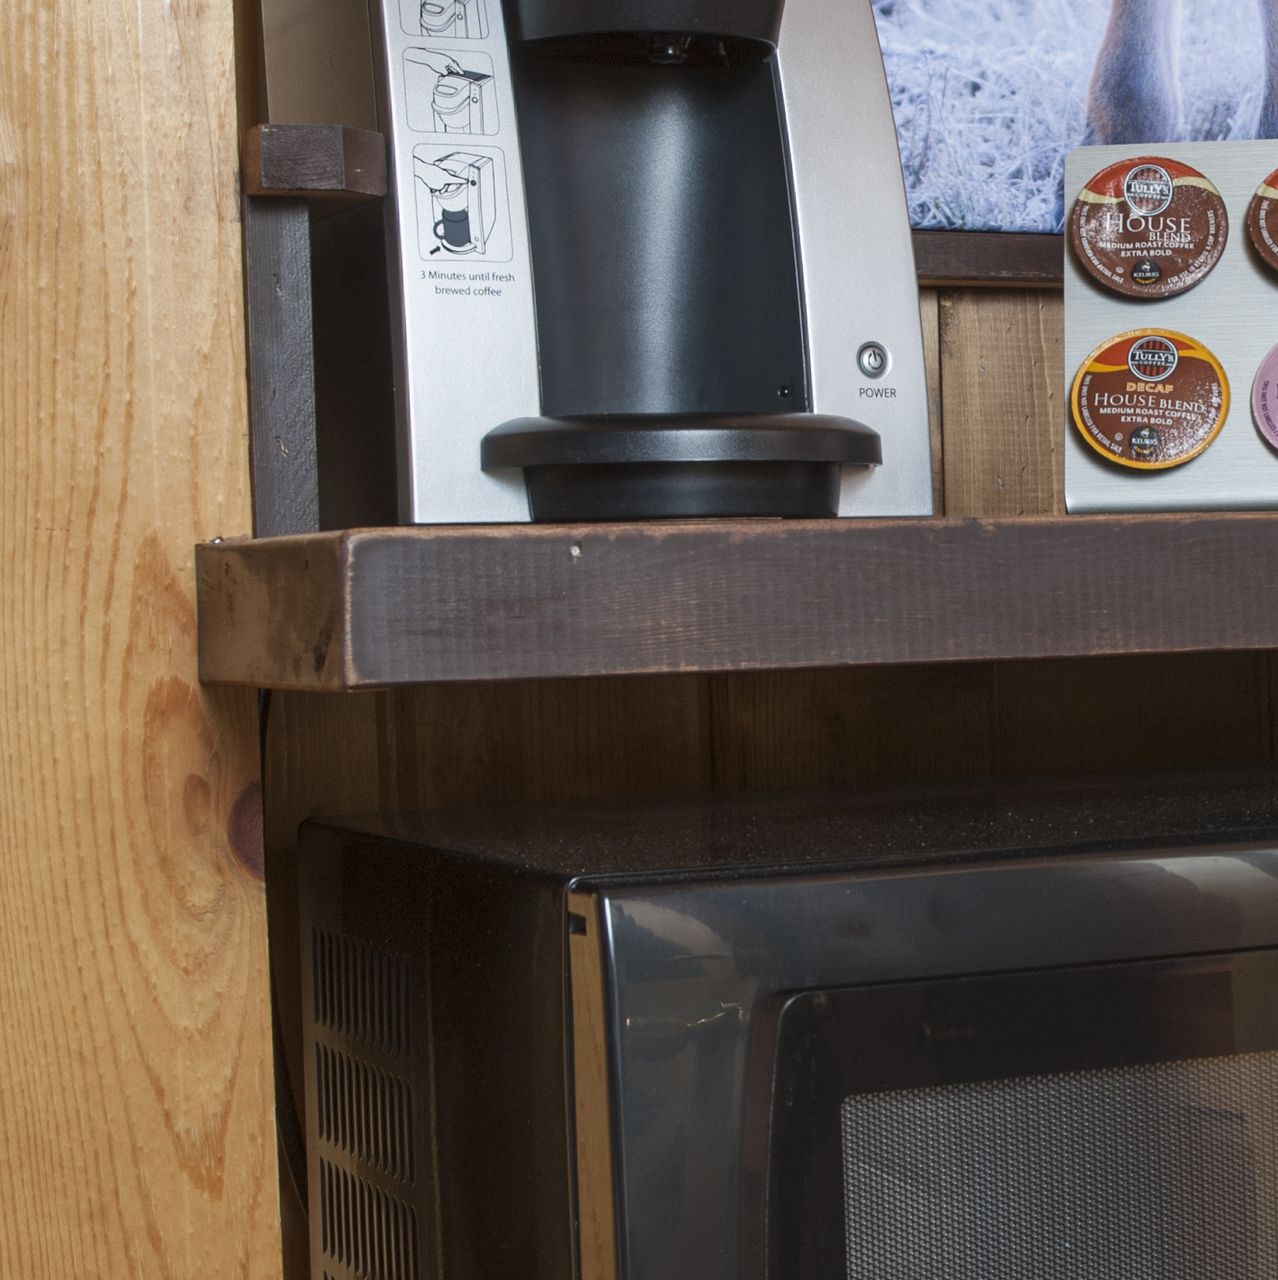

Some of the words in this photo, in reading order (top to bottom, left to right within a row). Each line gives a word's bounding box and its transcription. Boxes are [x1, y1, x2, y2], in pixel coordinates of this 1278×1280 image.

[1106, 211, 1191, 234] HOUSE
[1150, 232, 1191, 243] BLEND
[1135, 241, 1163, 249] ROAST
[419, 270, 426, 279] 3
[428, 270, 467, 281] Minutes
[468, 272, 490, 281] until
[492, 272, 515, 282] fresh
[435, 285, 471, 296] brewed
[473, 286, 502, 297] coffee
[1134, 351, 1175, 362] TULLY'S
[859, 387, 897, 398] POWER
[1126, 382, 1174, 394] DECAF
[1094, 392, 1157, 407] HOUSE
[1160, 399, 1205, 413] BLEND
[1135, 408, 1164, 416] ROAST
[1150, 417, 1173, 425] BOLD
